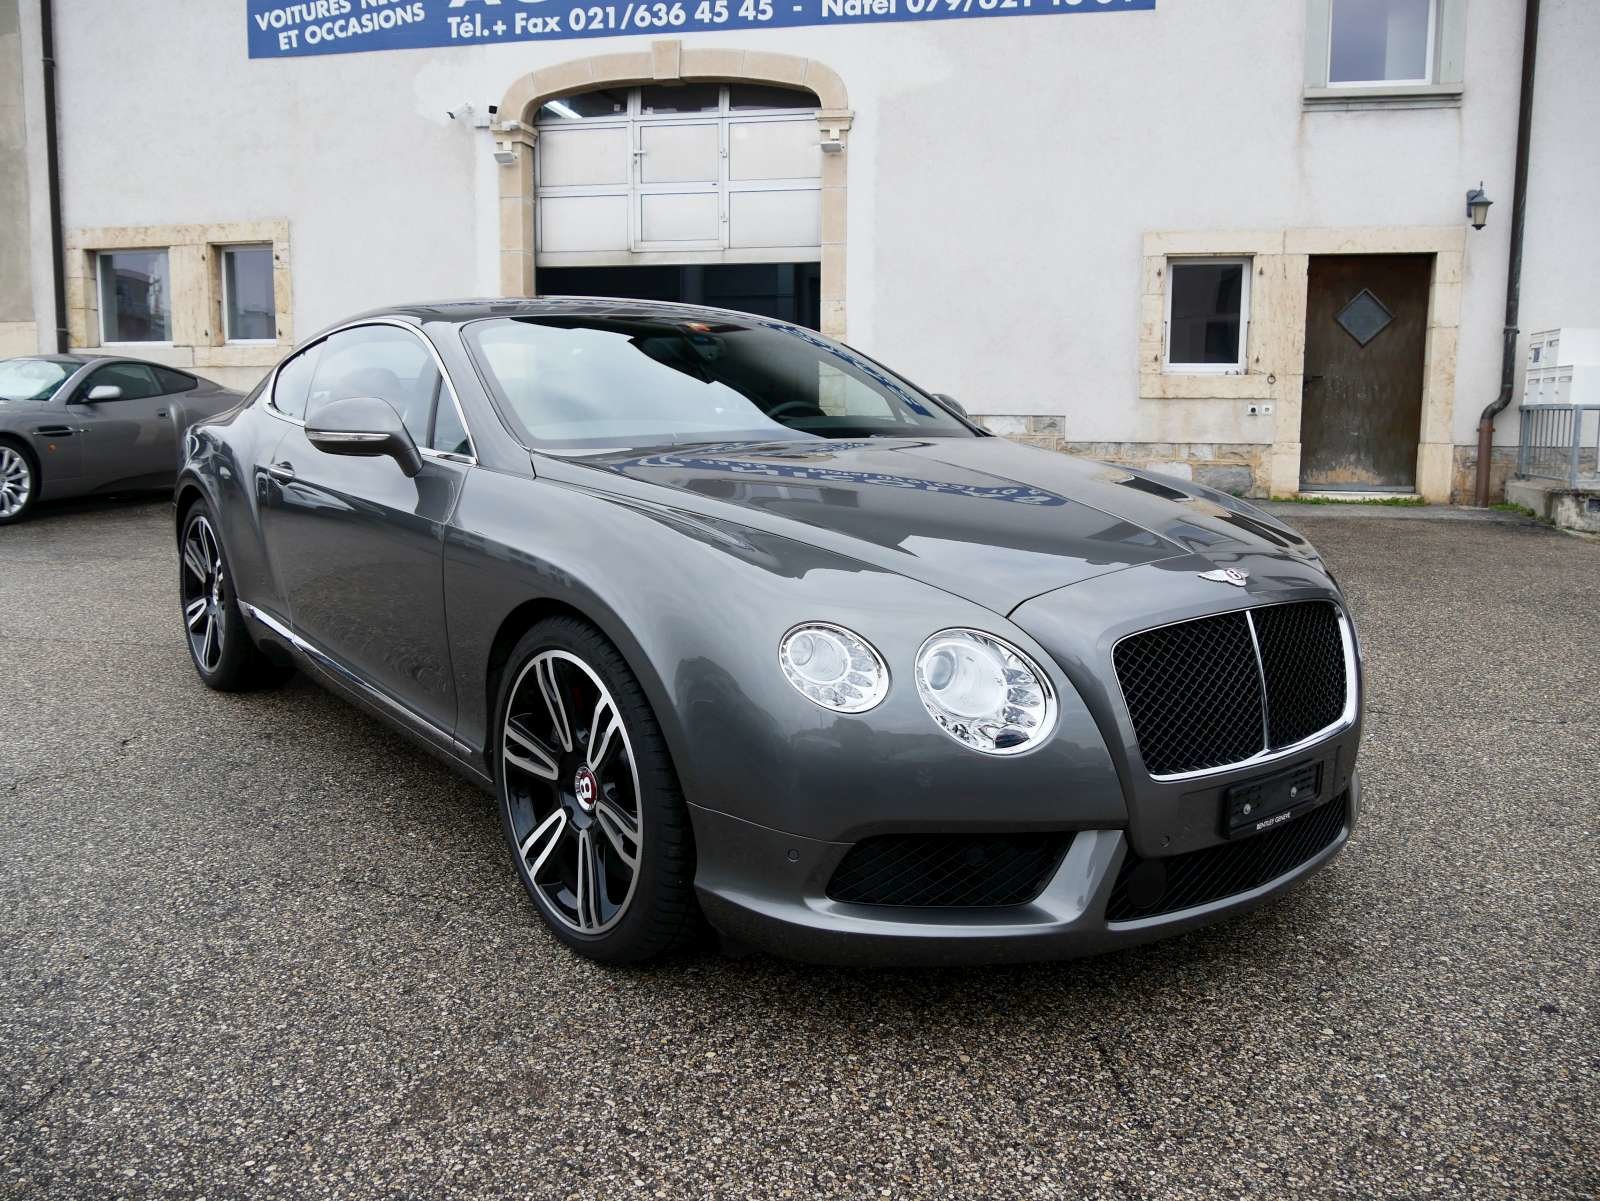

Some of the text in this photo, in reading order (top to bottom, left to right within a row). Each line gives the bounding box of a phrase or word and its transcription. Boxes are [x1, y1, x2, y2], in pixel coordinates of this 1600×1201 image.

[254, 0, 351, 31] VOITURES
[278, 3, 426, 51] ET OCCASIONS
[514, 12, 562, 35] Fax
[568, 2, 687, 32] 021/636
[694, 0, 729, 24] 45
[738, 0, 774, 22] 45
[821, 0, 897, 17] Natel
